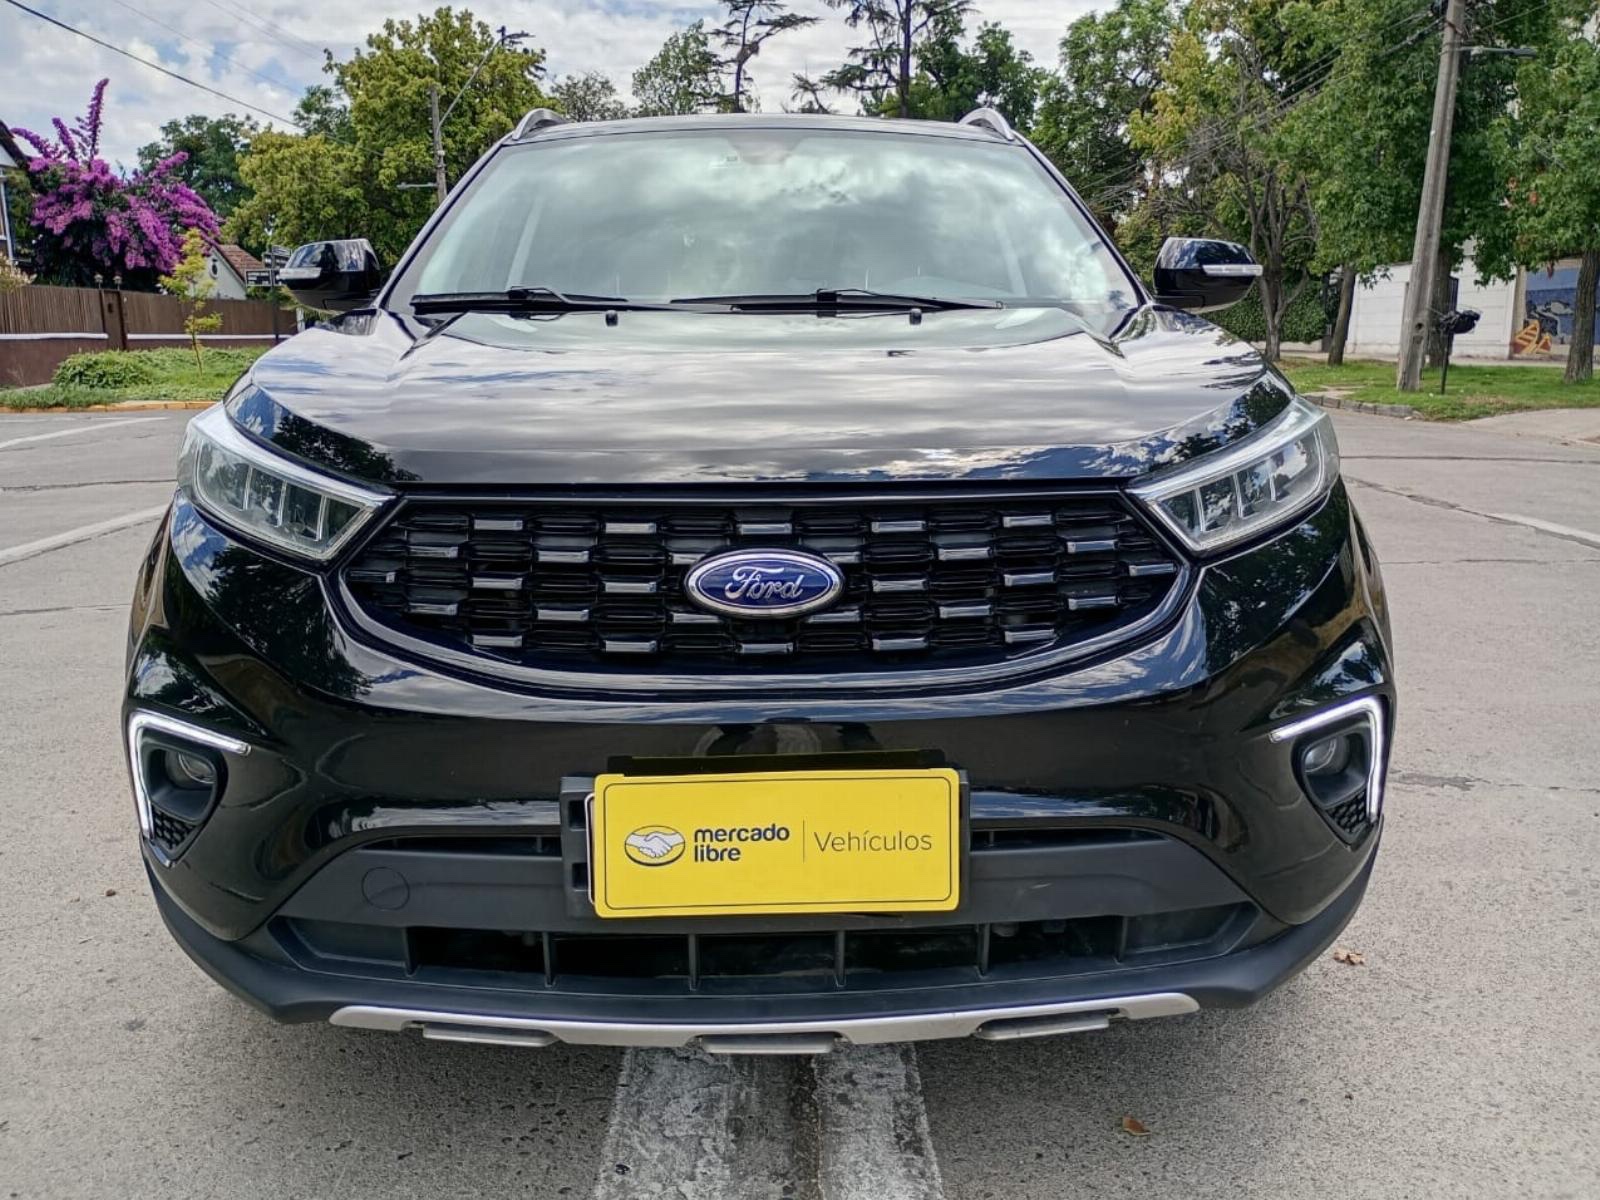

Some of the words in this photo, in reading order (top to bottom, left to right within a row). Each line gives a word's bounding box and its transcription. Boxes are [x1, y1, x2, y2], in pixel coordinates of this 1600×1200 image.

[724, 565, 804, 600] Ford
[693, 823, 790, 843] mercado
[813, 830, 932, 853] Vehículos
[693, 844, 741, 863] libre
